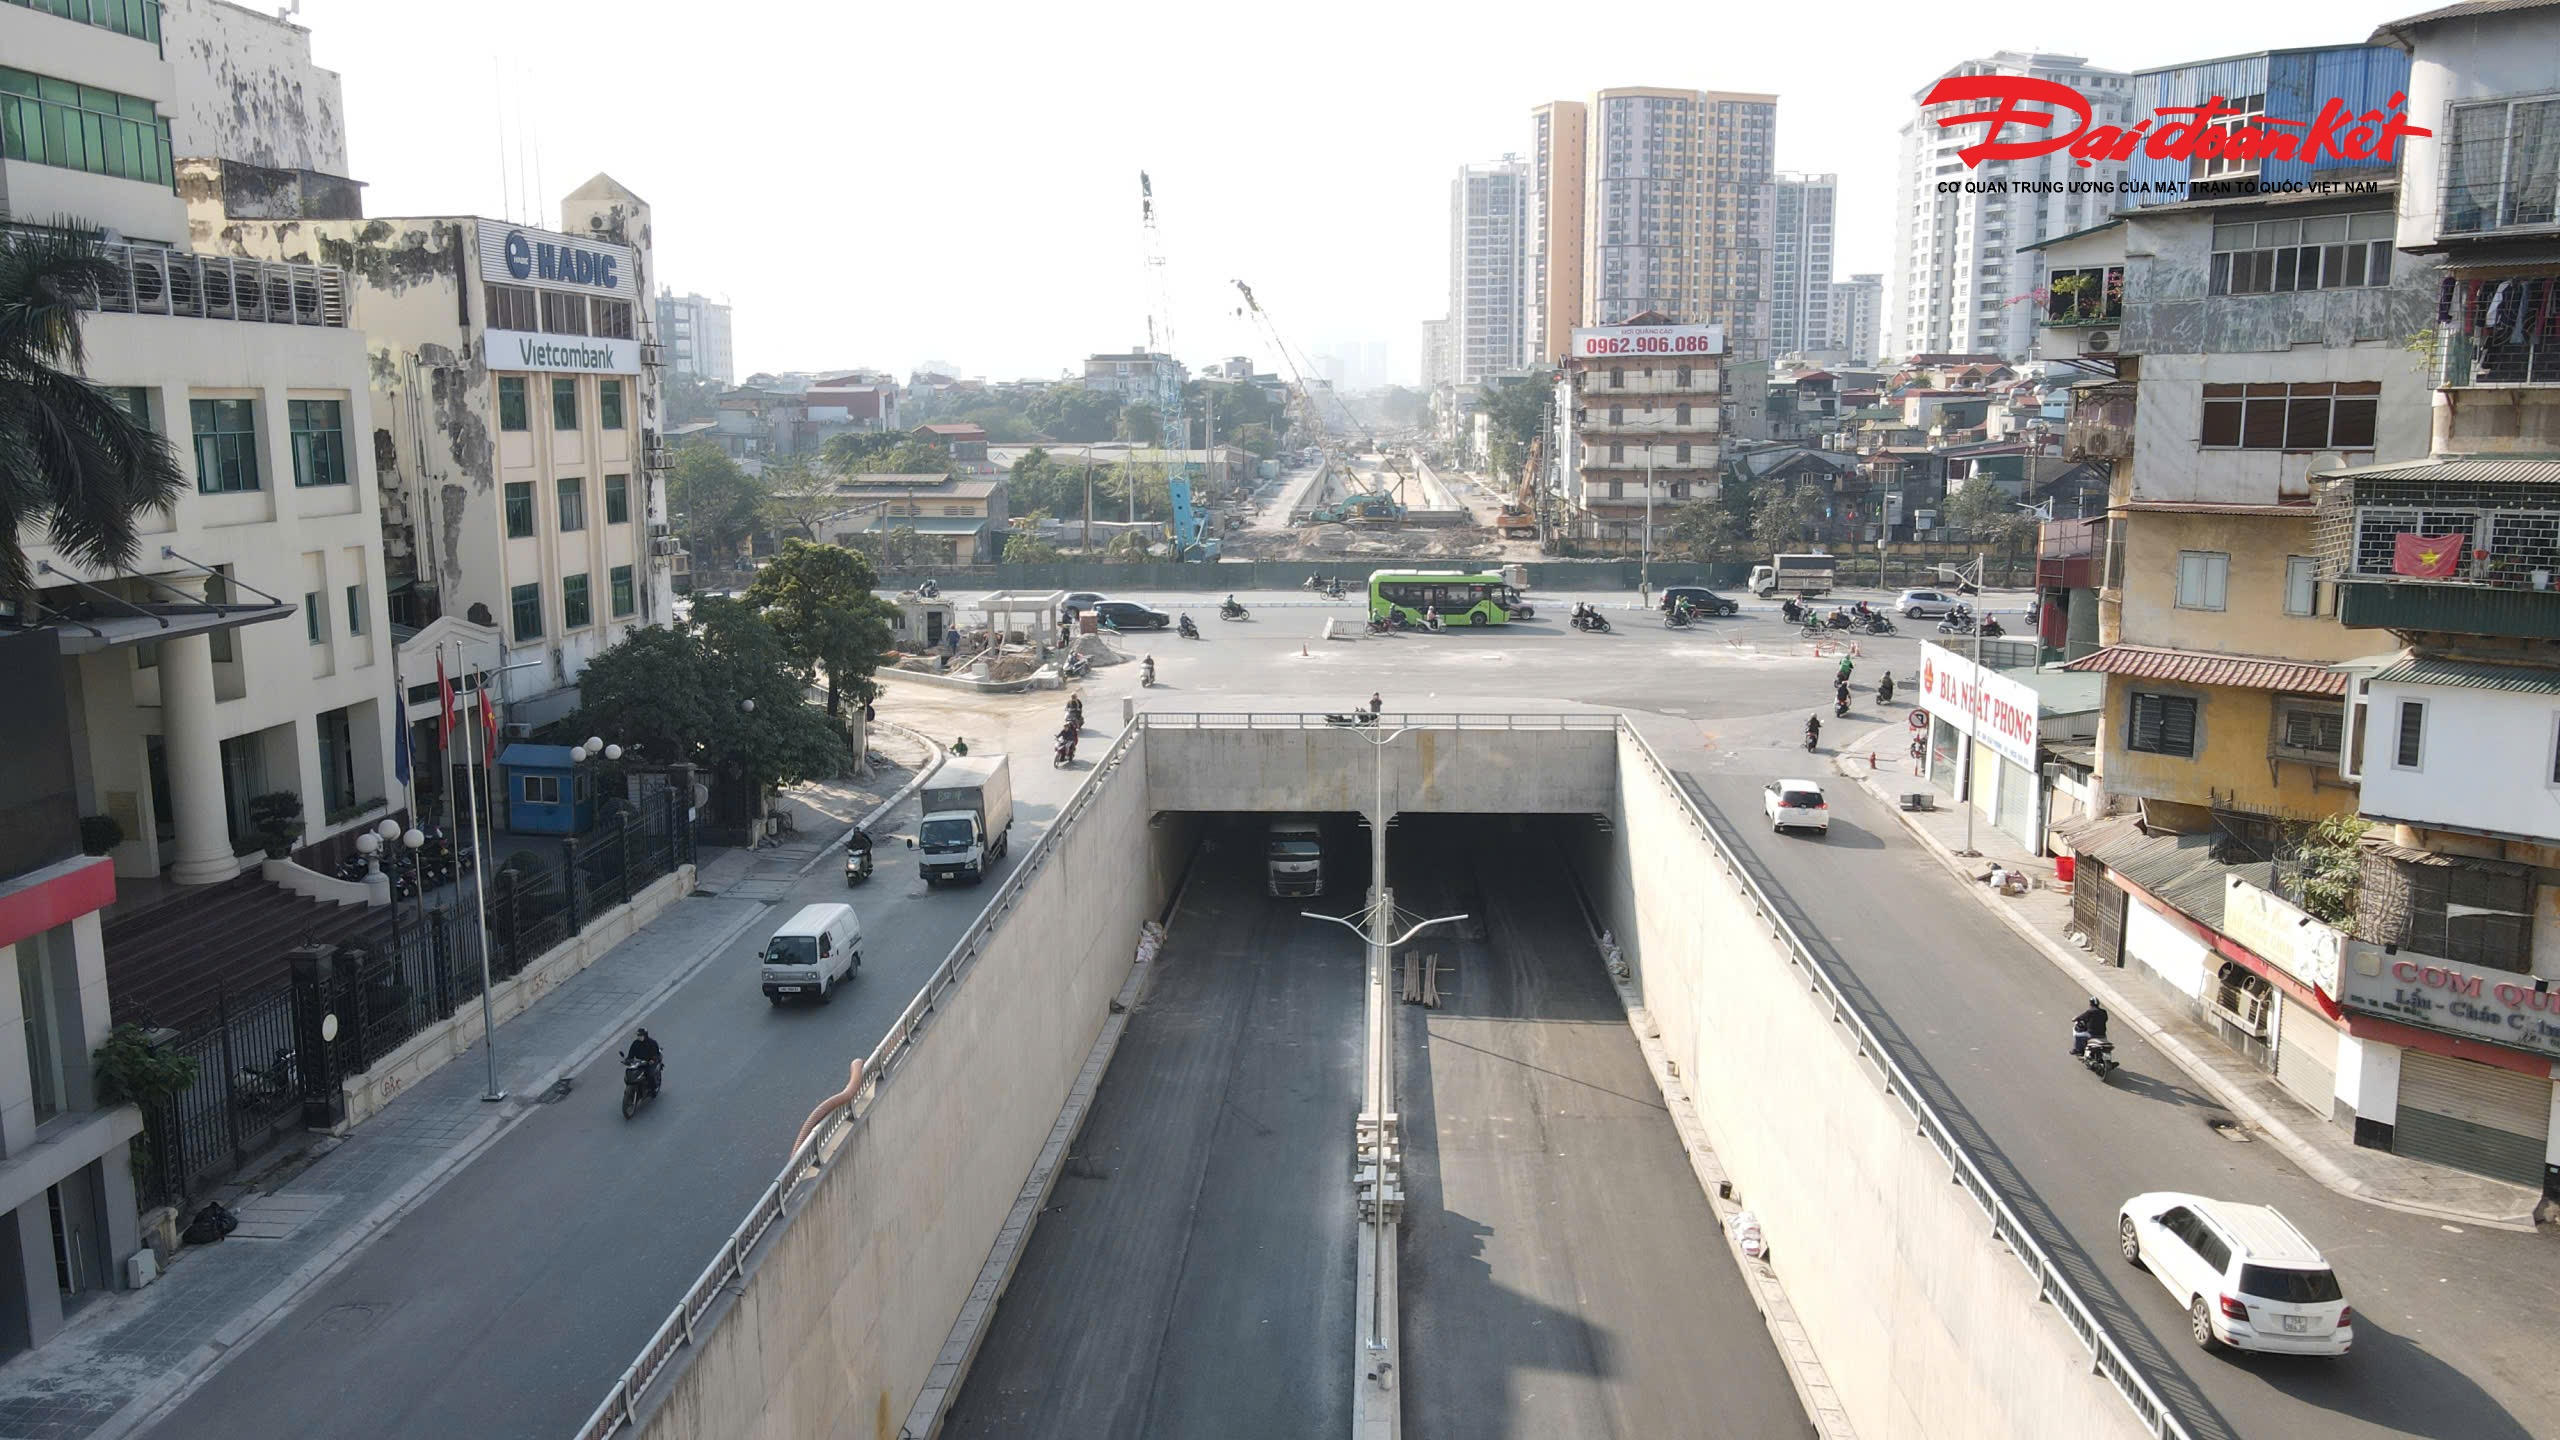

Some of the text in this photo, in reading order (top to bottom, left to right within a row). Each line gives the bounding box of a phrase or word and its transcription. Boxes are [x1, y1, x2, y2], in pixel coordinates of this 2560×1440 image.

[537, 243, 618, 289] HADIC
[519, 338, 615, 369] Vietcombank
[1586, 335, 1709, 354] 0962.906.086
[1940, 671, 1957, 706] BIA
[1993, 698, 2032, 745] PHONG
[2391, 961, 2484, 998] CƠM
